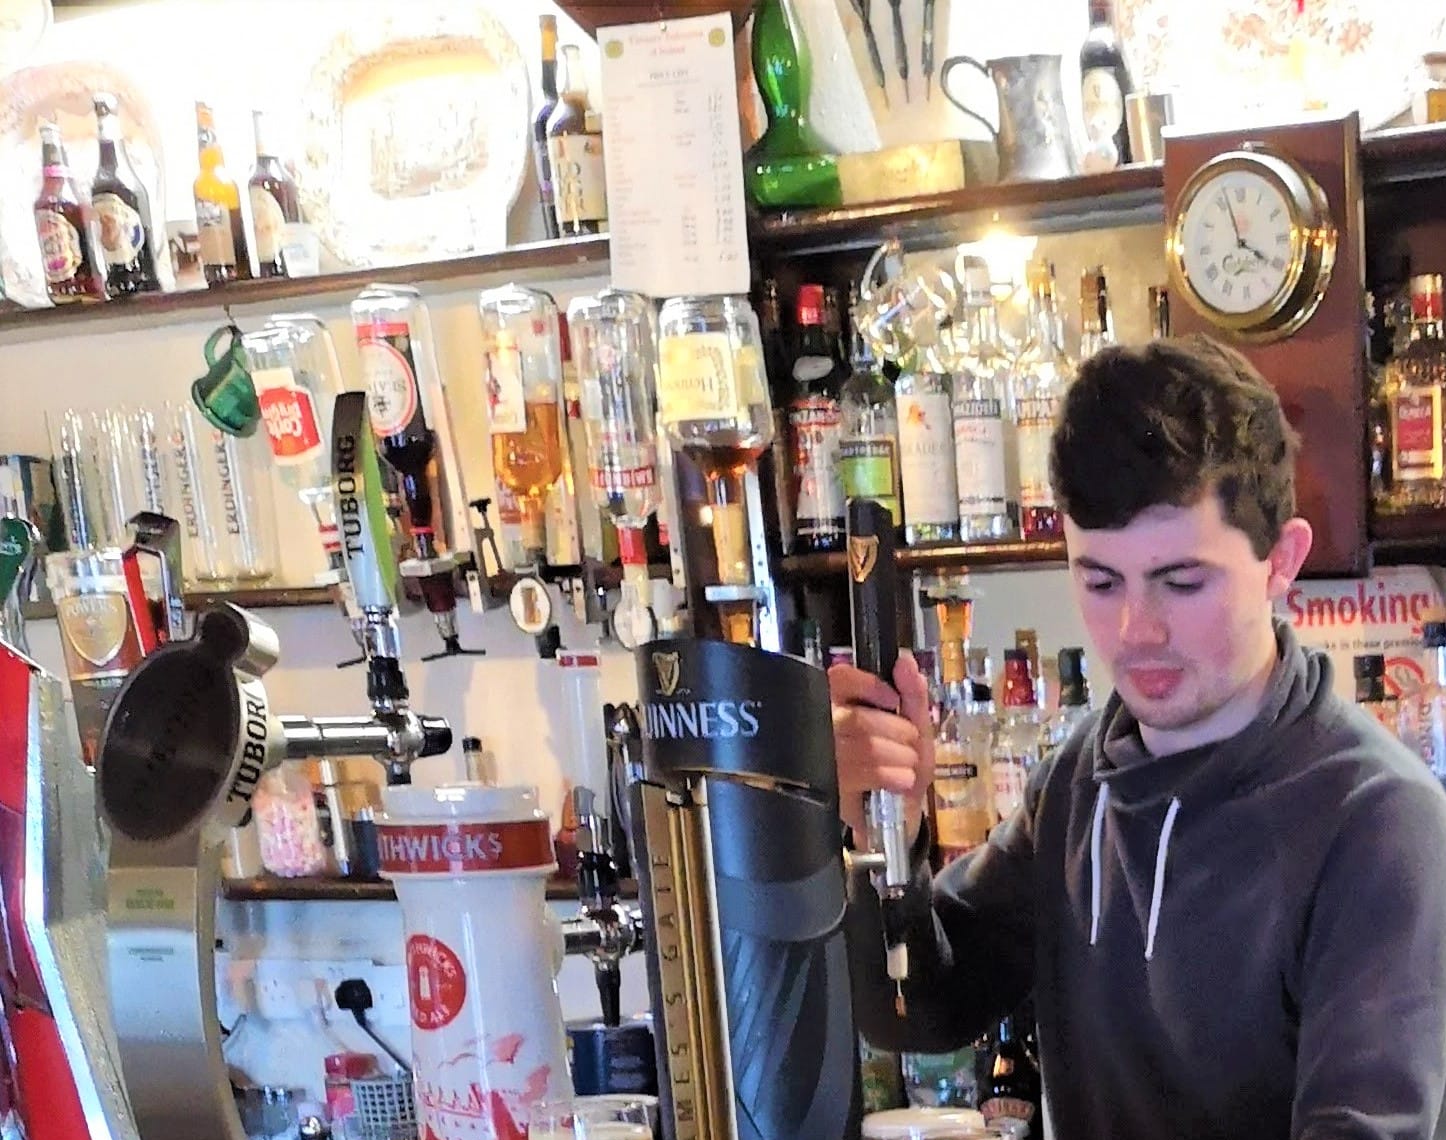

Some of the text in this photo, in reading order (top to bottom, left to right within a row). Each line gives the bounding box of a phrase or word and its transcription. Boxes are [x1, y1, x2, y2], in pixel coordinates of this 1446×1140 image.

[266, 417, 302, 441] Cork
[172, 439, 200, 538] ERDINGER
[214, 440, 240, 536] ERDINGER
[337, 434, 364, 561] TUBORG
[1286, 581, 1430, 635] Smoking
[636, 699, 762, 740] UINNESS
[651, 854, 678, 963] GATE
